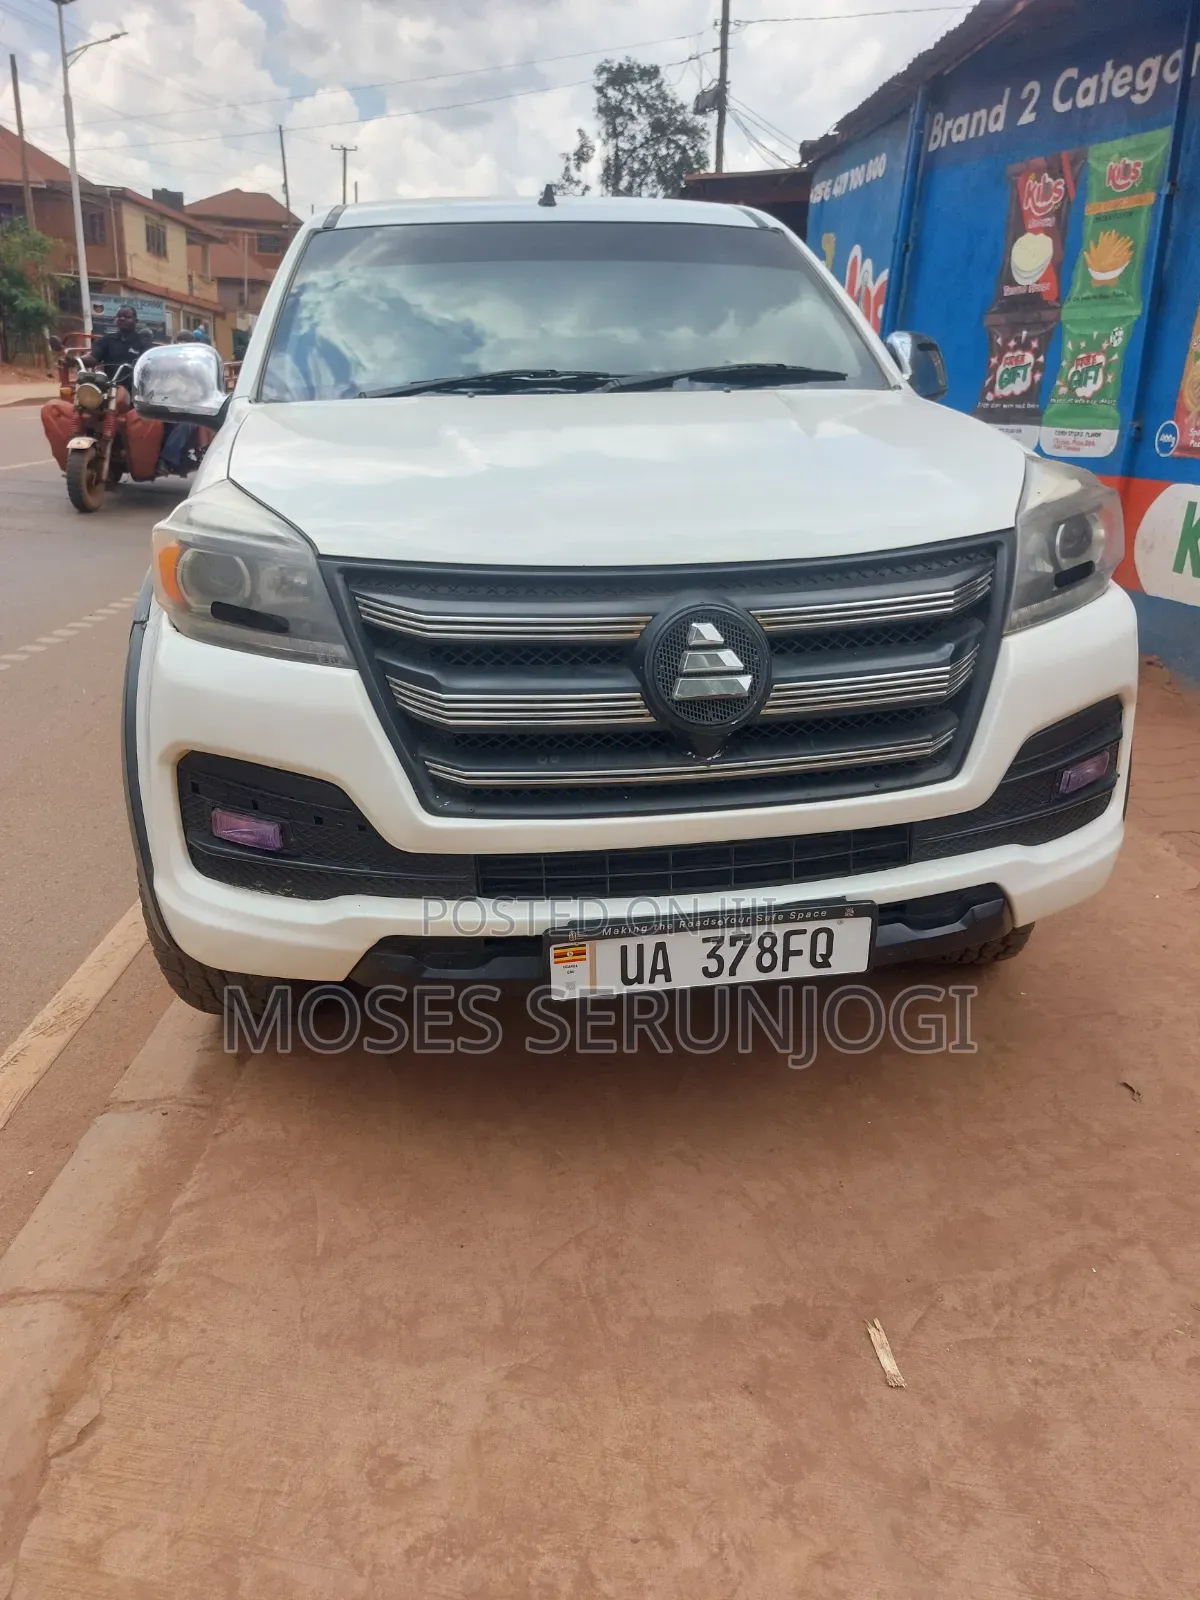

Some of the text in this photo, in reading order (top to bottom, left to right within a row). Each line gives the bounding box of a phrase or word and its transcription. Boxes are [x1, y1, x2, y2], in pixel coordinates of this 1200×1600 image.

[928, 88, 1010, 152] Brand
[1017, 81, 1041, 126] 2
[999, 362, 1031, 390] GIFT
[1069, 362, 1103, 391] GIFT
[602, 926, 648, 937] Making
[654, 922, 673, 931] the
[756, 913, 784, 922] Safe
[790, 910, 827, 921] Space
[619, 926, 835, 986] UA 378FQ
